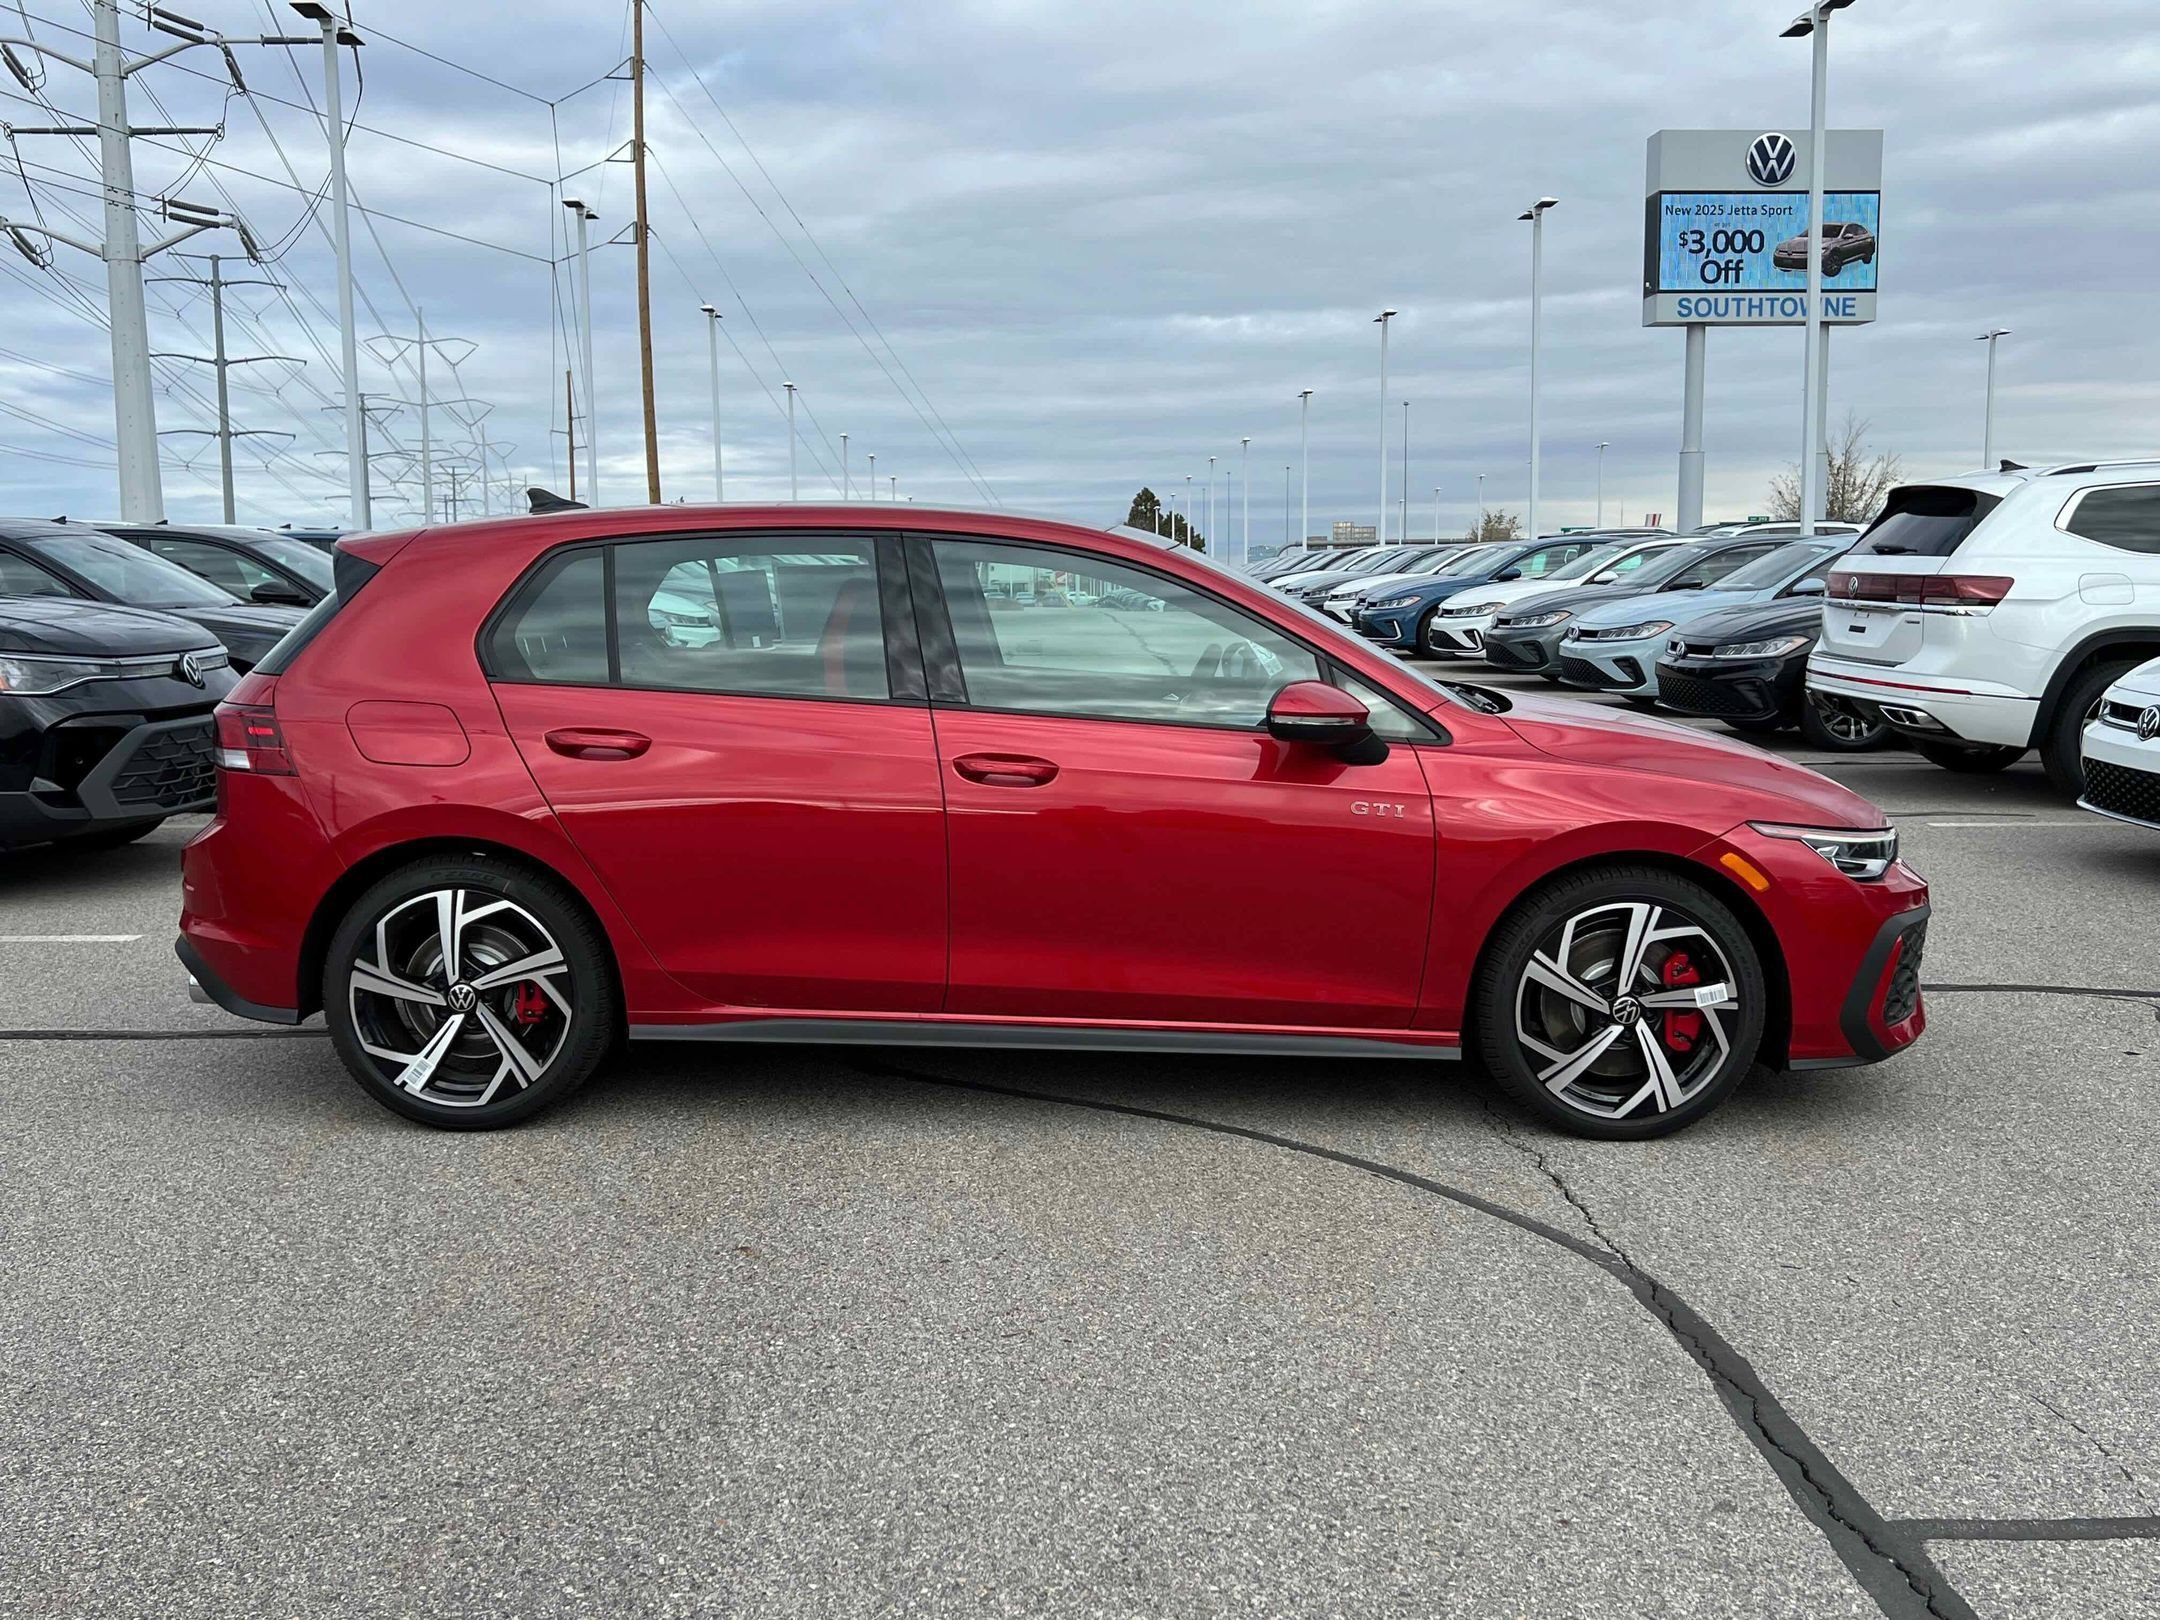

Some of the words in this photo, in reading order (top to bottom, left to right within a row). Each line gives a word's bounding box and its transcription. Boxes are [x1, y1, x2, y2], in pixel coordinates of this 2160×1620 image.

[1746, 132, 1796, 187] VW
[1665, 205, 1692, 216] New
[1694, 205, 1724, 216] 2025
[1727, 205, 1758, 216] Jetta
[1760, 205, 1793, 218] Sport
[1678, 229, 1765, 259] $3,000
[1700, 259, 1745, 284] Off
[1350, 801, 1405, 818] GTI
[447, 984, 476, 1012] VW
